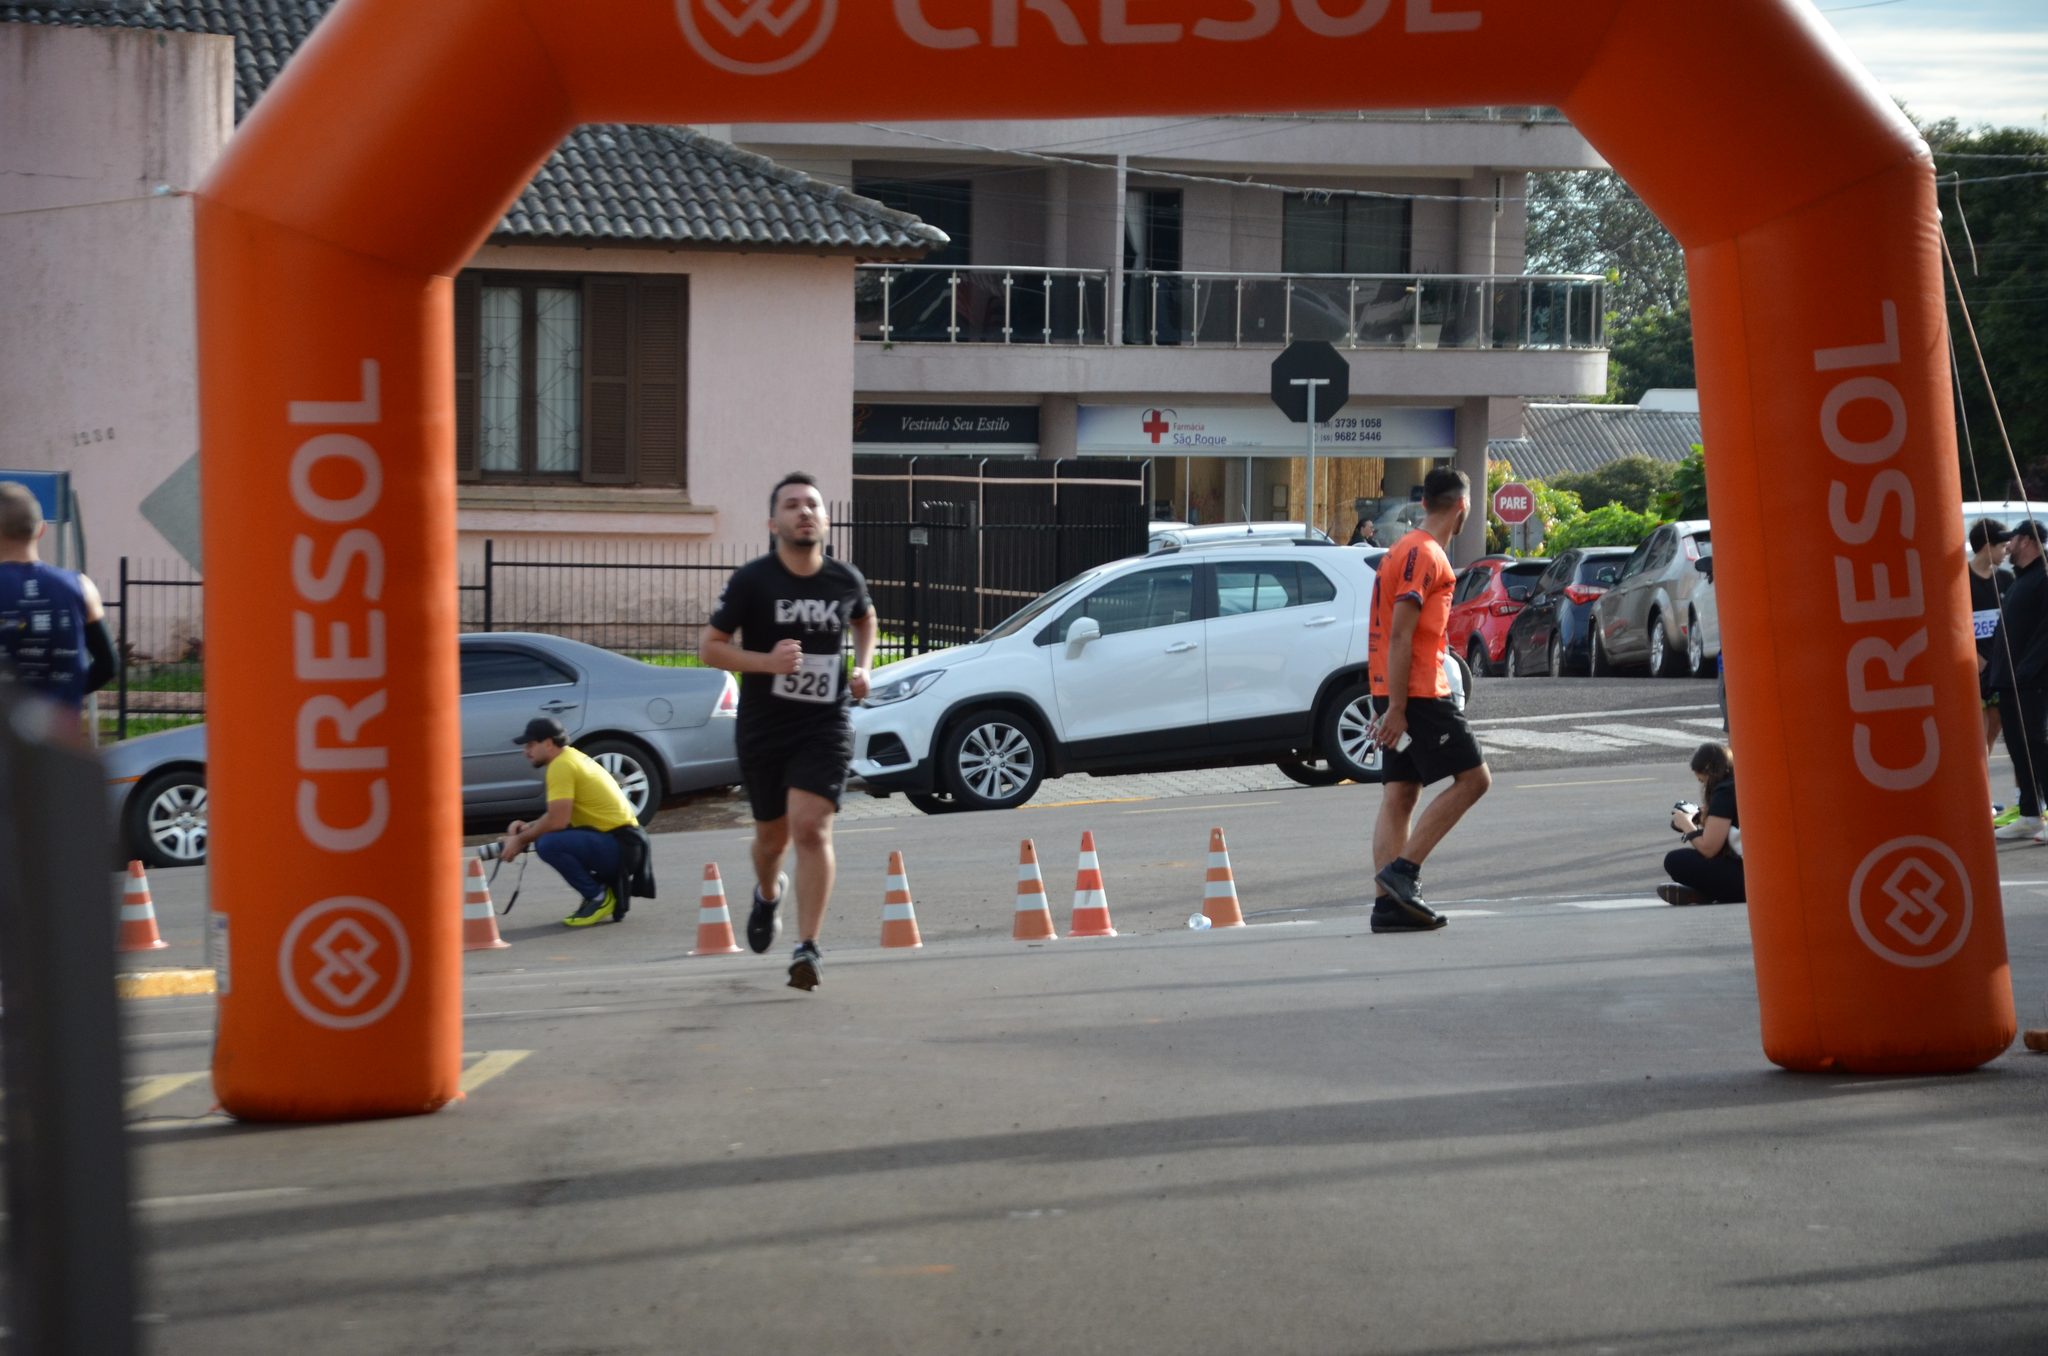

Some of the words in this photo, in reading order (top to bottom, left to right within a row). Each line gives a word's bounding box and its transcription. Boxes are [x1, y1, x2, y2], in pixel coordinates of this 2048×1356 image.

[901, 416, 949, 431] Vestindo
[952, 416, 974, 431] Seu
[977, 417, 1010, 431] Estilo
[1173, 422, 1205, 431] Farmácia
[1335, 418, 1357, 428] 3739
[1361, 418, 1382, 428] 1058
[1173, 433, 1192, 446] São
[1195, 434, 1227, 446] Roque
[1335, 431, 1357, 441] 9682
[1360, 431, 1382, 441] 5446
[1500, 496, 1528, 510] PARE
[1814, 298, 1940, 791] CRESOL
[286, 357, 391, 854] CRESOL
[775, 599, 841, 623] DARK
[783, 671, 831, 697] 528
